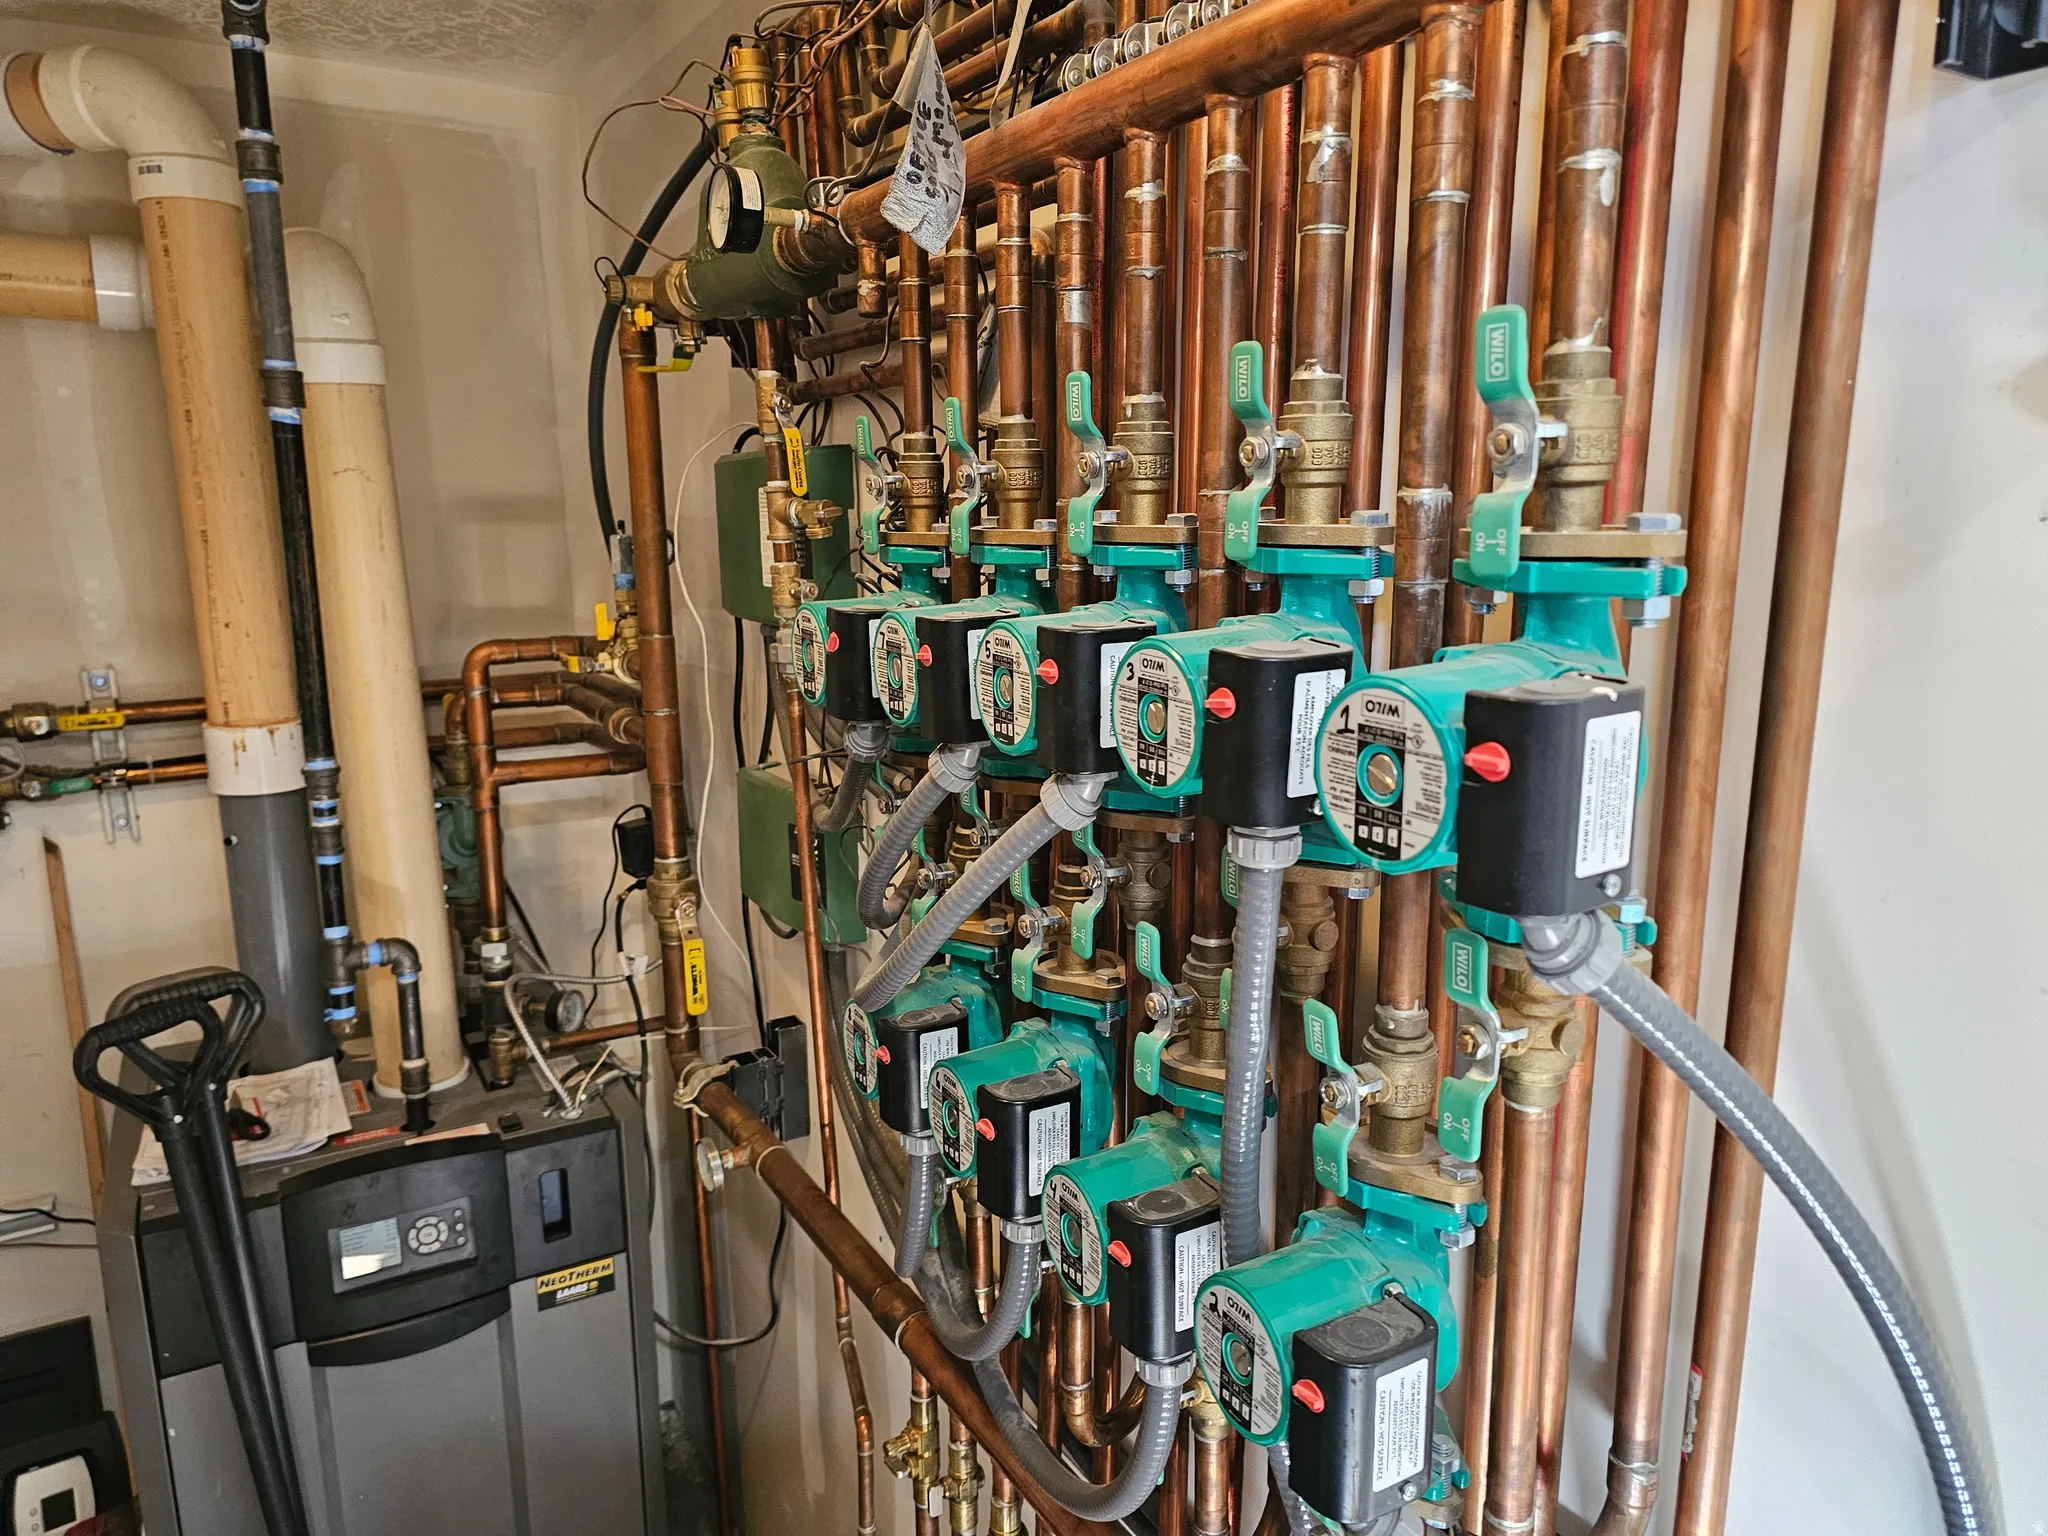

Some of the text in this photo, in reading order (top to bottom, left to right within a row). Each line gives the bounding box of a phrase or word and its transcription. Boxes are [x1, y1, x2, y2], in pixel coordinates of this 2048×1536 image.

[1490, 328, 1505, 377] WILO
[1238, 359, 1249, 398] WILO
[1072, 385, 1080, 418] WILO
[1070, 523, 1076, 537] ON
[1228, 523, 1236, 539] ON
[1241, 520, 1249, 544] OFF
[1475, 531, 1485, 553] ON
[1496, 528, 1507, 556] OFF
[879, 631, 886, 648] 7
[887, 626, 899, 635] WILO
[984, 640, 992, 660] 5
[994, 637, 1012, 650] WILO
[1126, 662, 1135, 681] 3
[1142, 658, 1166, 673] WILO
[1336, 704, 1355, 734] 1
[1365, 700, 1400, 718] WILO
[1072, 926, 1078, 940] ON
[1140, 938, 1149, 968] WILO
[1456, 949, 1470, 988] WILO
[1312, 1021, 1324, 1054] WILO
[1135, 1059, 1142, 1074] ON
[1144, 1062, 1152, 1084] OFF
[944, 1074, 956, 1088] WILO
[1442, 1112, 1453, 1131] ON
[1460, 1117, 1471, 1143] OFF
[1316, 1156, 1324, 1172] ON
[1330, 1162, 1339, 1185] OFF
[1062, 1183, 1078, 1203] WILO
[1227, 1296, 1252, 1325] WILO
[1378, 1390, 1386, 1425] CAUTION
